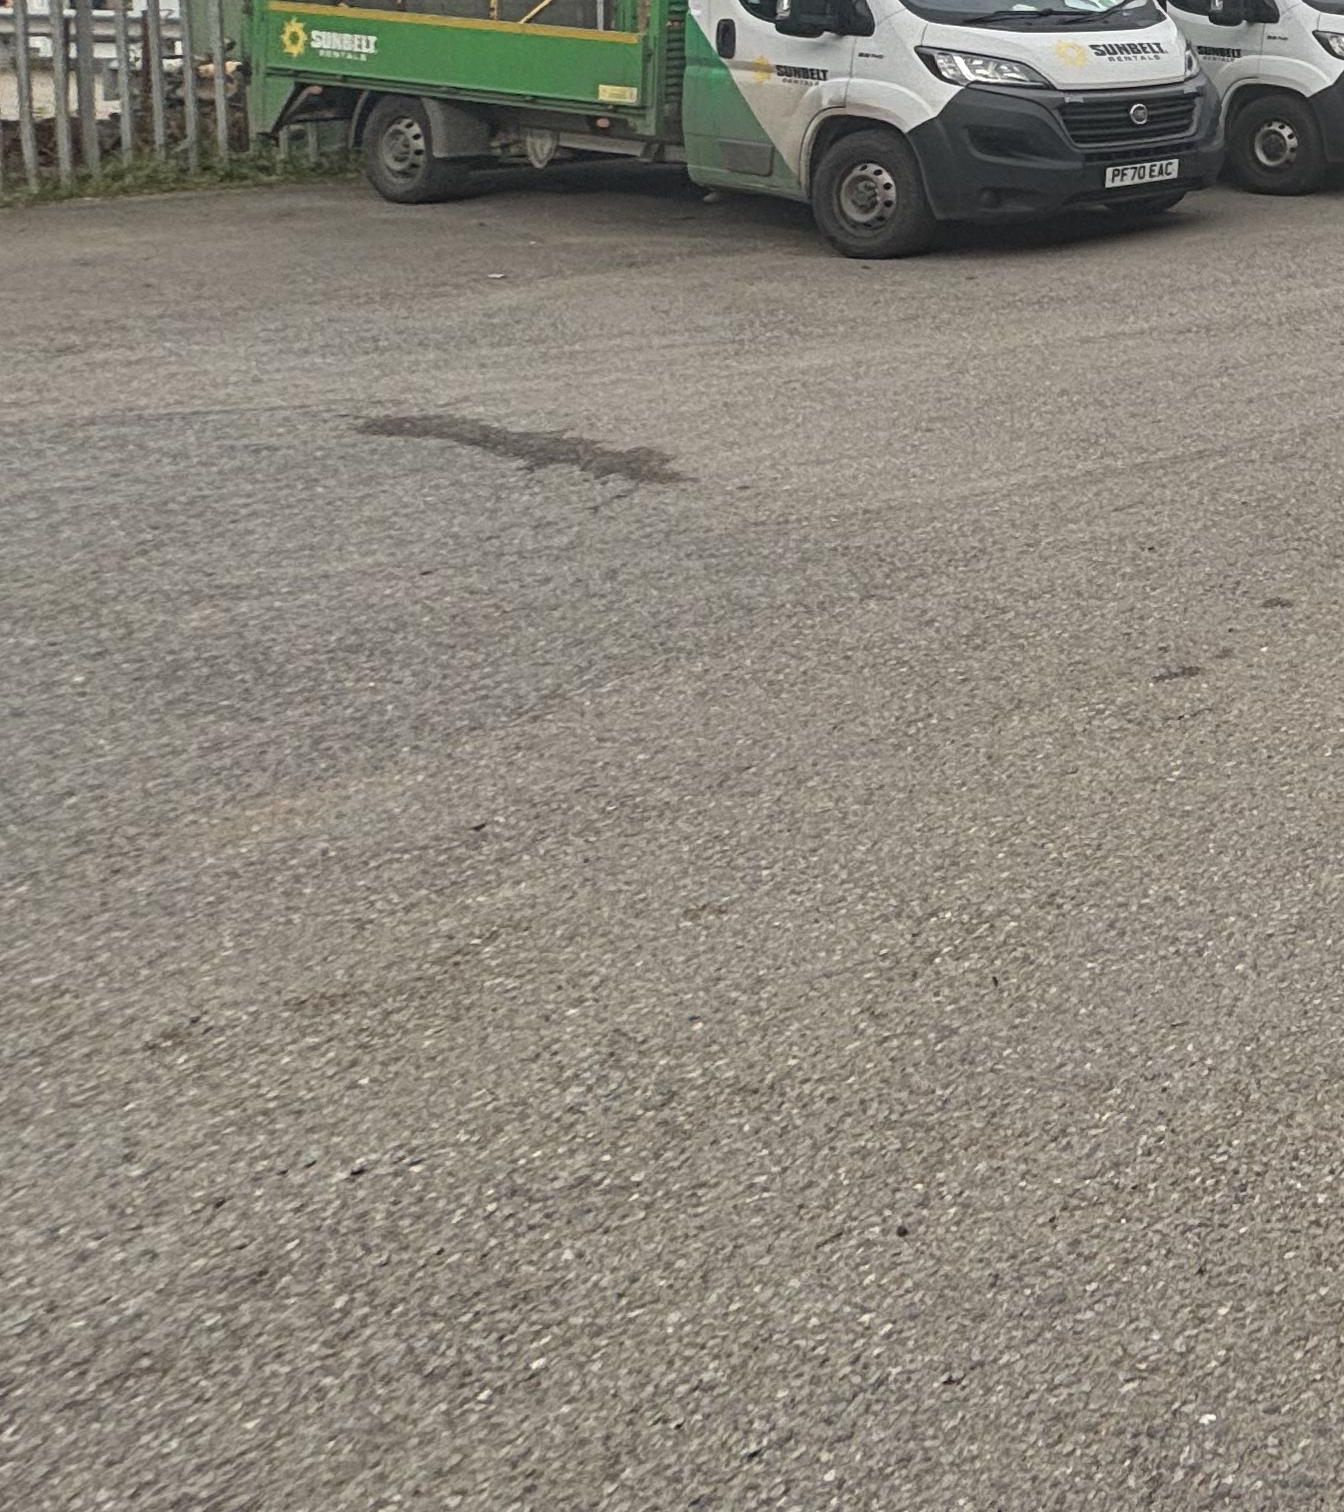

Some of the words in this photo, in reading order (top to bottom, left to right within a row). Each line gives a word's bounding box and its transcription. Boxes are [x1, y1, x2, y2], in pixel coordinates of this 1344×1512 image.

[311, 30, 377, 54] SUNBELT
[1088, 42, 1165, 57] SUNBELT
[1107, 54, 1161, 63] RENTALS
[775, 64, 829, 82] SUNBELT
[1111, 165, 1147, 184] PF70
[1148, 161, 1174, 179] EAC
